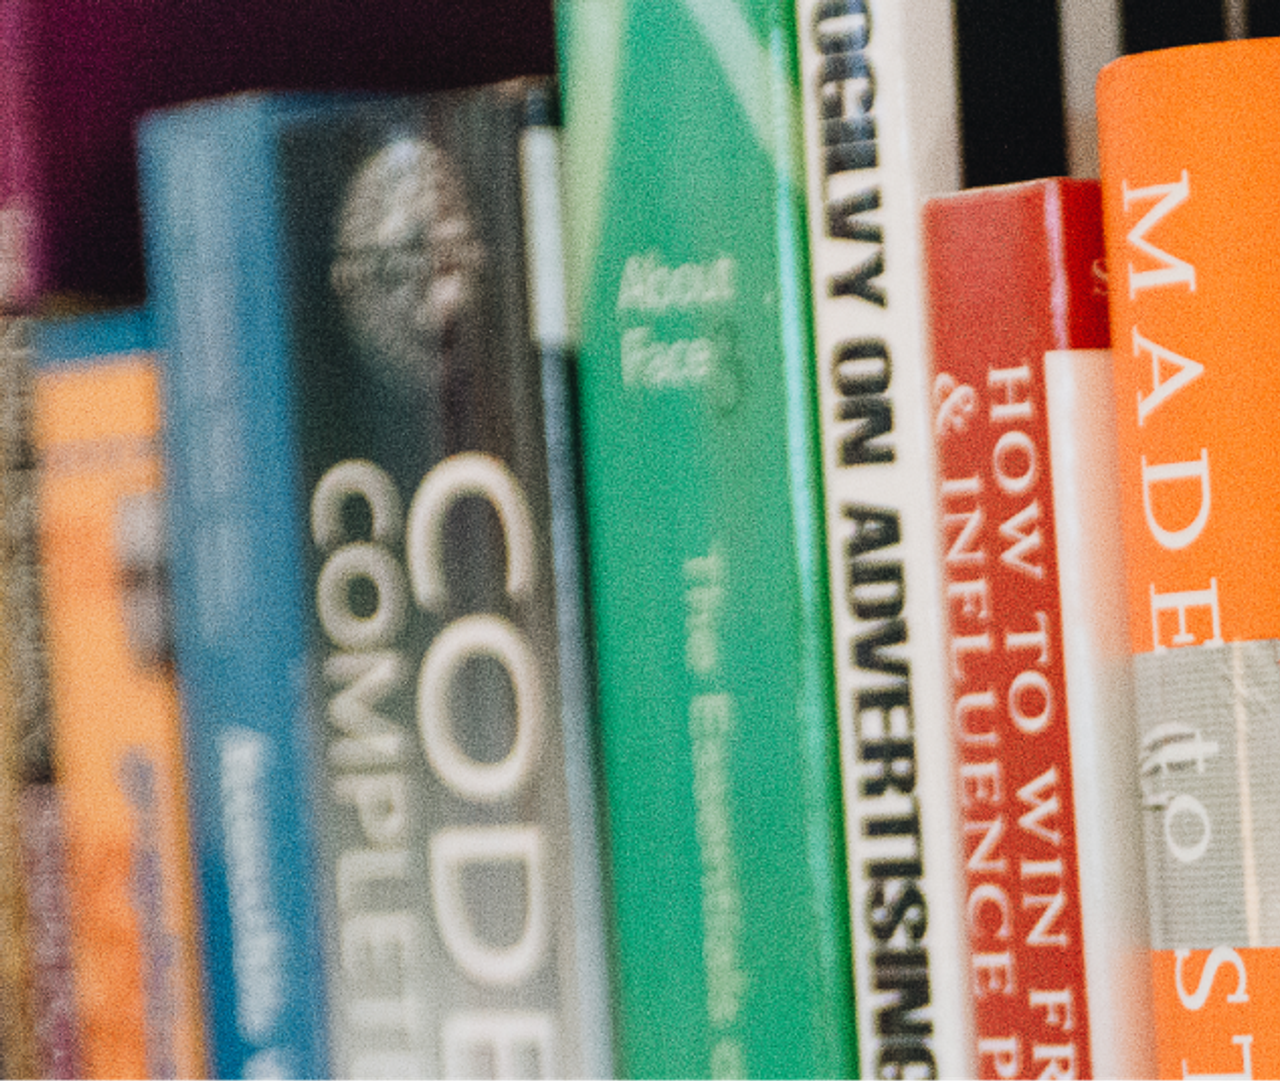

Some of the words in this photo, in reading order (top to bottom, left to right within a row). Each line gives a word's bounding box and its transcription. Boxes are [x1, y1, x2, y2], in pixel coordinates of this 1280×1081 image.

[810, 0, 888, 307] OGILVY
[617, 251, 736, 313] About
[620, 327, 713, 390] Face
[829, 337, 896, 468] ON
[934, 371, 980, 437] &
[987, 364, 1044, 580] HOW
[1122, 169, 1224, 655] MADE
[940, 473, 1015, 997] INFLUENCE
[1003, 611, 1056, 734] TO
[842, 500, 940, 1081] ADVERTISING
[1016, 767, 1071, 949] WIN
